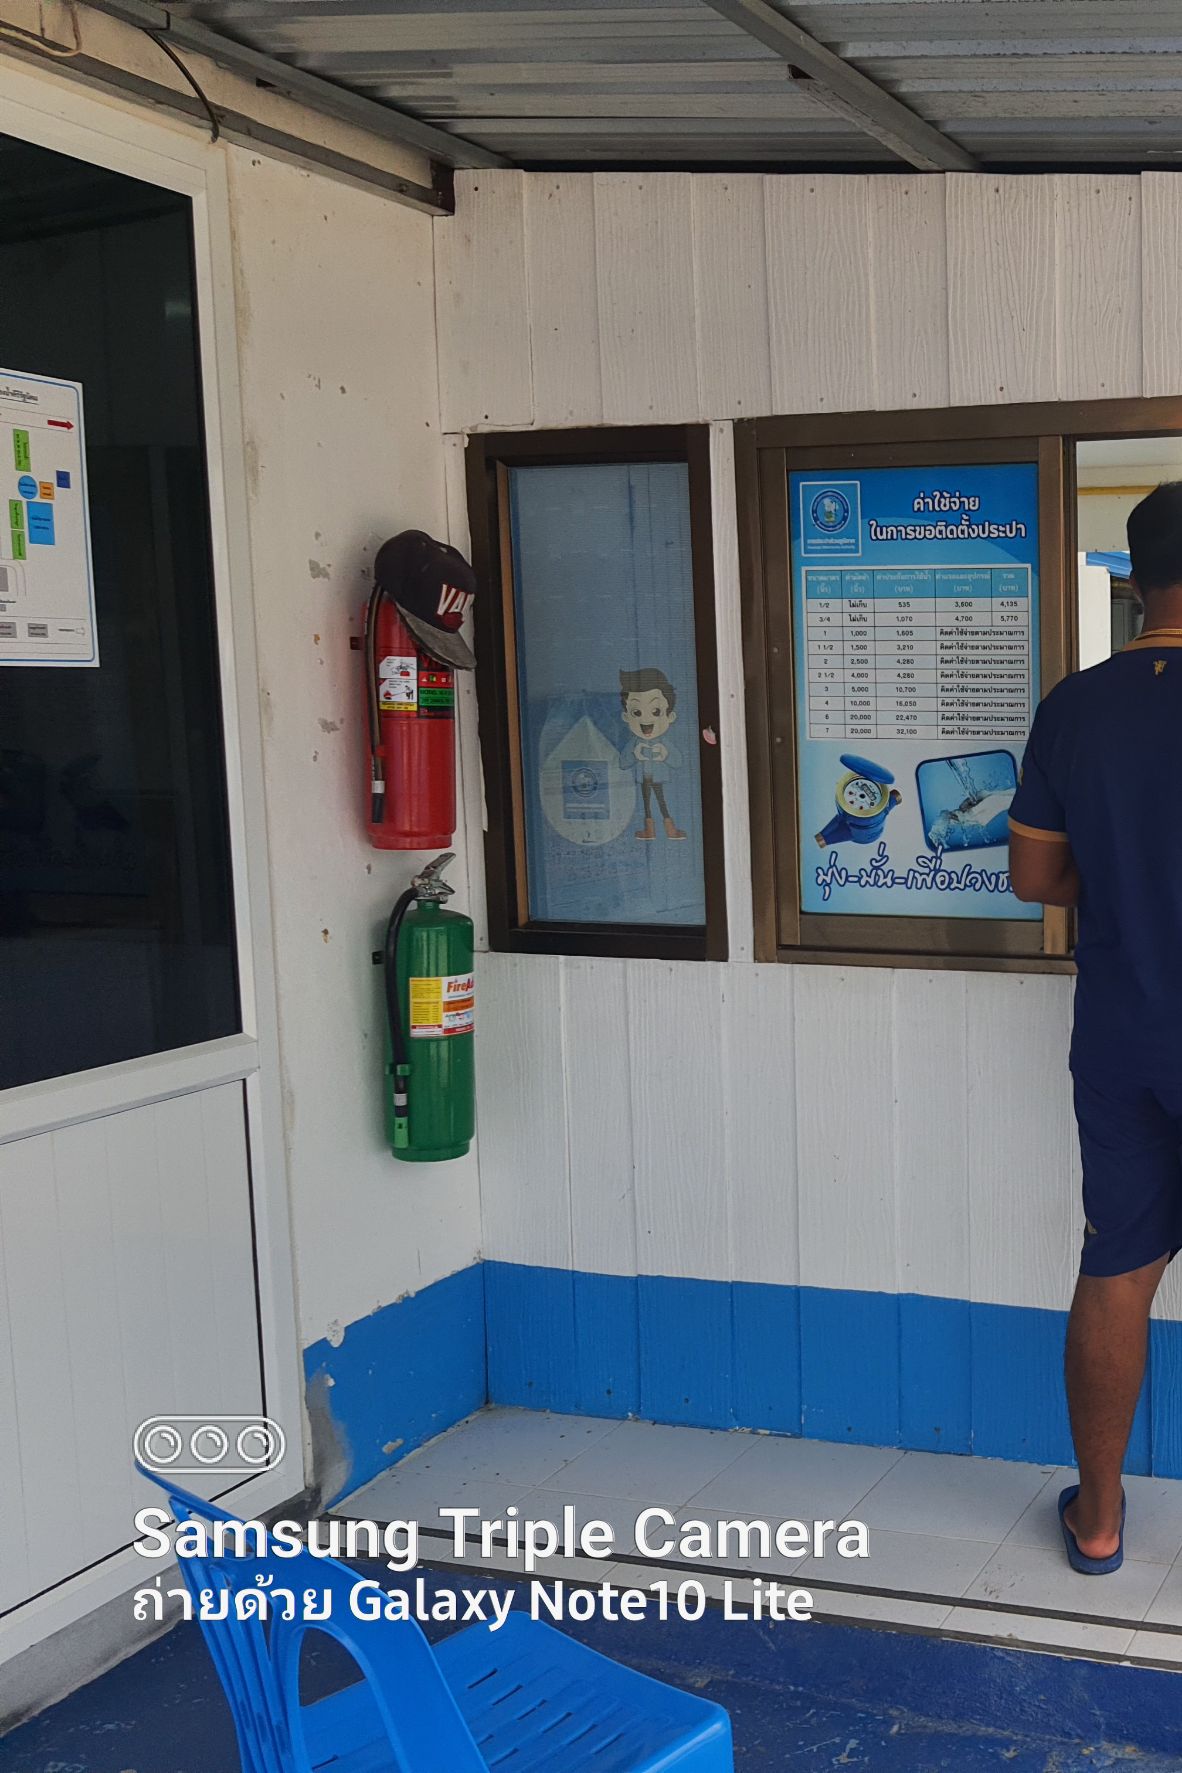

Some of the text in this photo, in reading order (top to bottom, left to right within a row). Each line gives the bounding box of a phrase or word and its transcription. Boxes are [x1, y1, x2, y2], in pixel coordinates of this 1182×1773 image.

[913, 490, 980, 512] ค่าใช้จ่าย
[869, 514, 1026, 540] ในการขอติดตั้งประปา
[816, 841, 1012, 901] มุ่ง-มั่น-เพื่อปวงช
